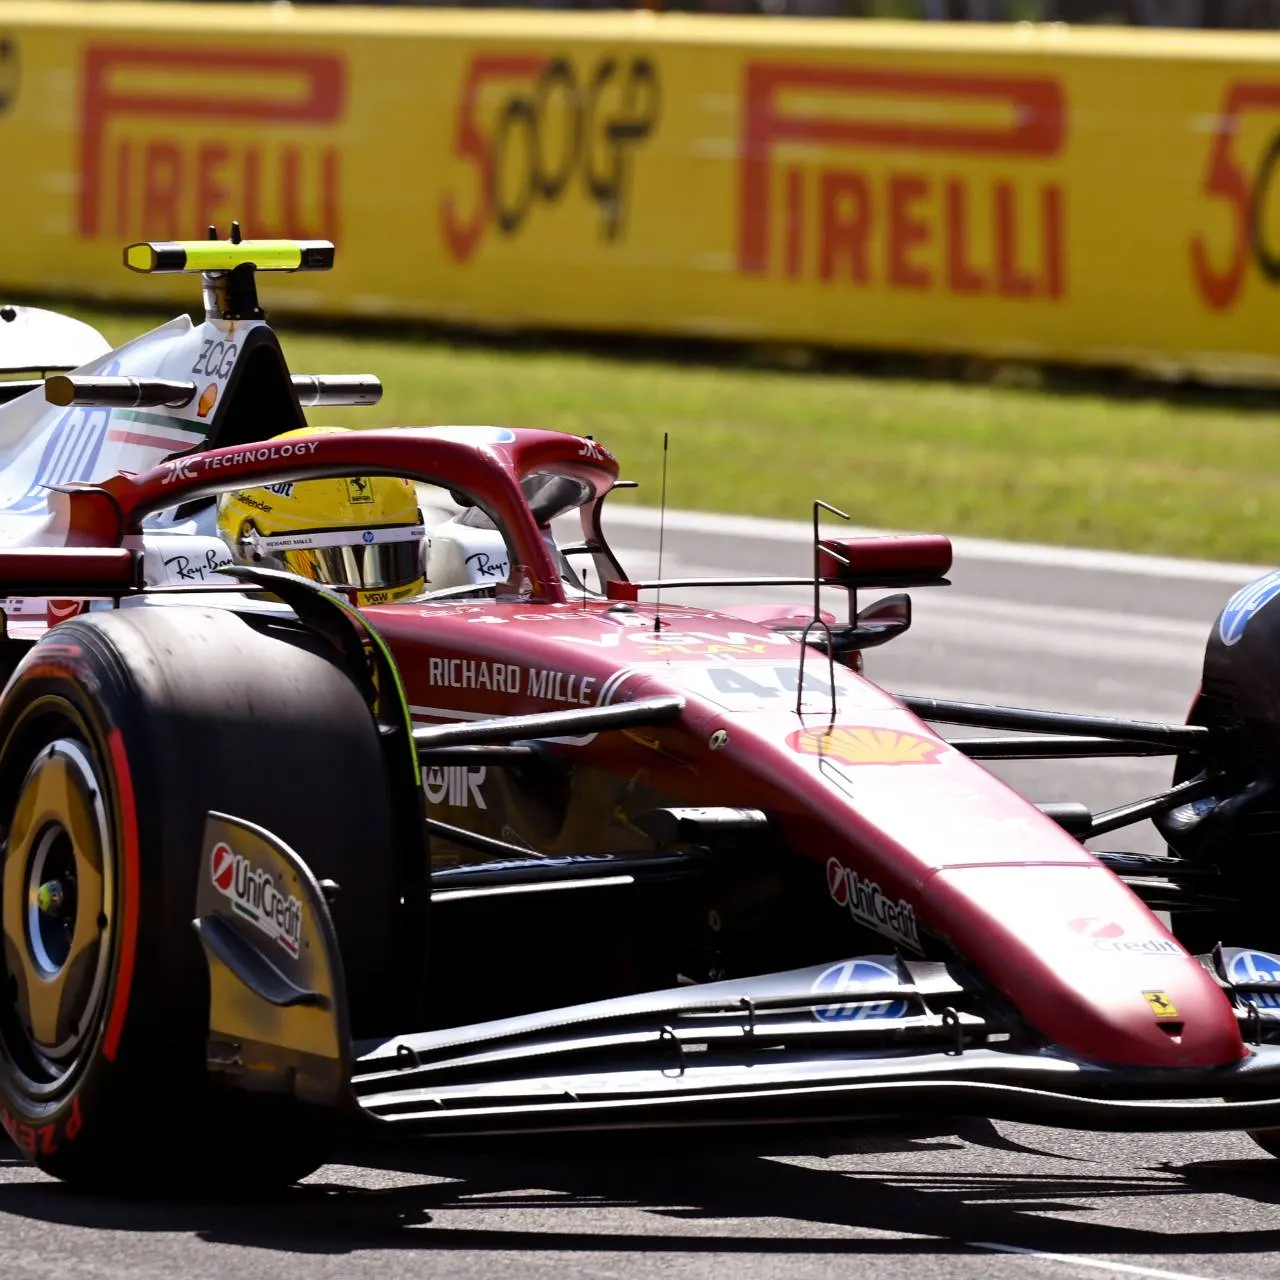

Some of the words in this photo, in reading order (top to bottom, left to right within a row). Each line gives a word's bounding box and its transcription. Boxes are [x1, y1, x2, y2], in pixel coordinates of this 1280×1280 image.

[77, 41, 348, 255] PIRELLI
[735, 59, 1068, 303] PIRELLI
[192, 339, 237, 380] ZCG
[204, 441, 318, 471] TECHNOLOGY
[238, 492, 272, 513] defender
[429, 657, 521, 694] RICHARD
[526, 667, 597, 705] MILLE
[707, 667, 848, 698] 44
[235, 855, 303, 943] UniCredit
[845, 868, 919, 943] UniCredit
